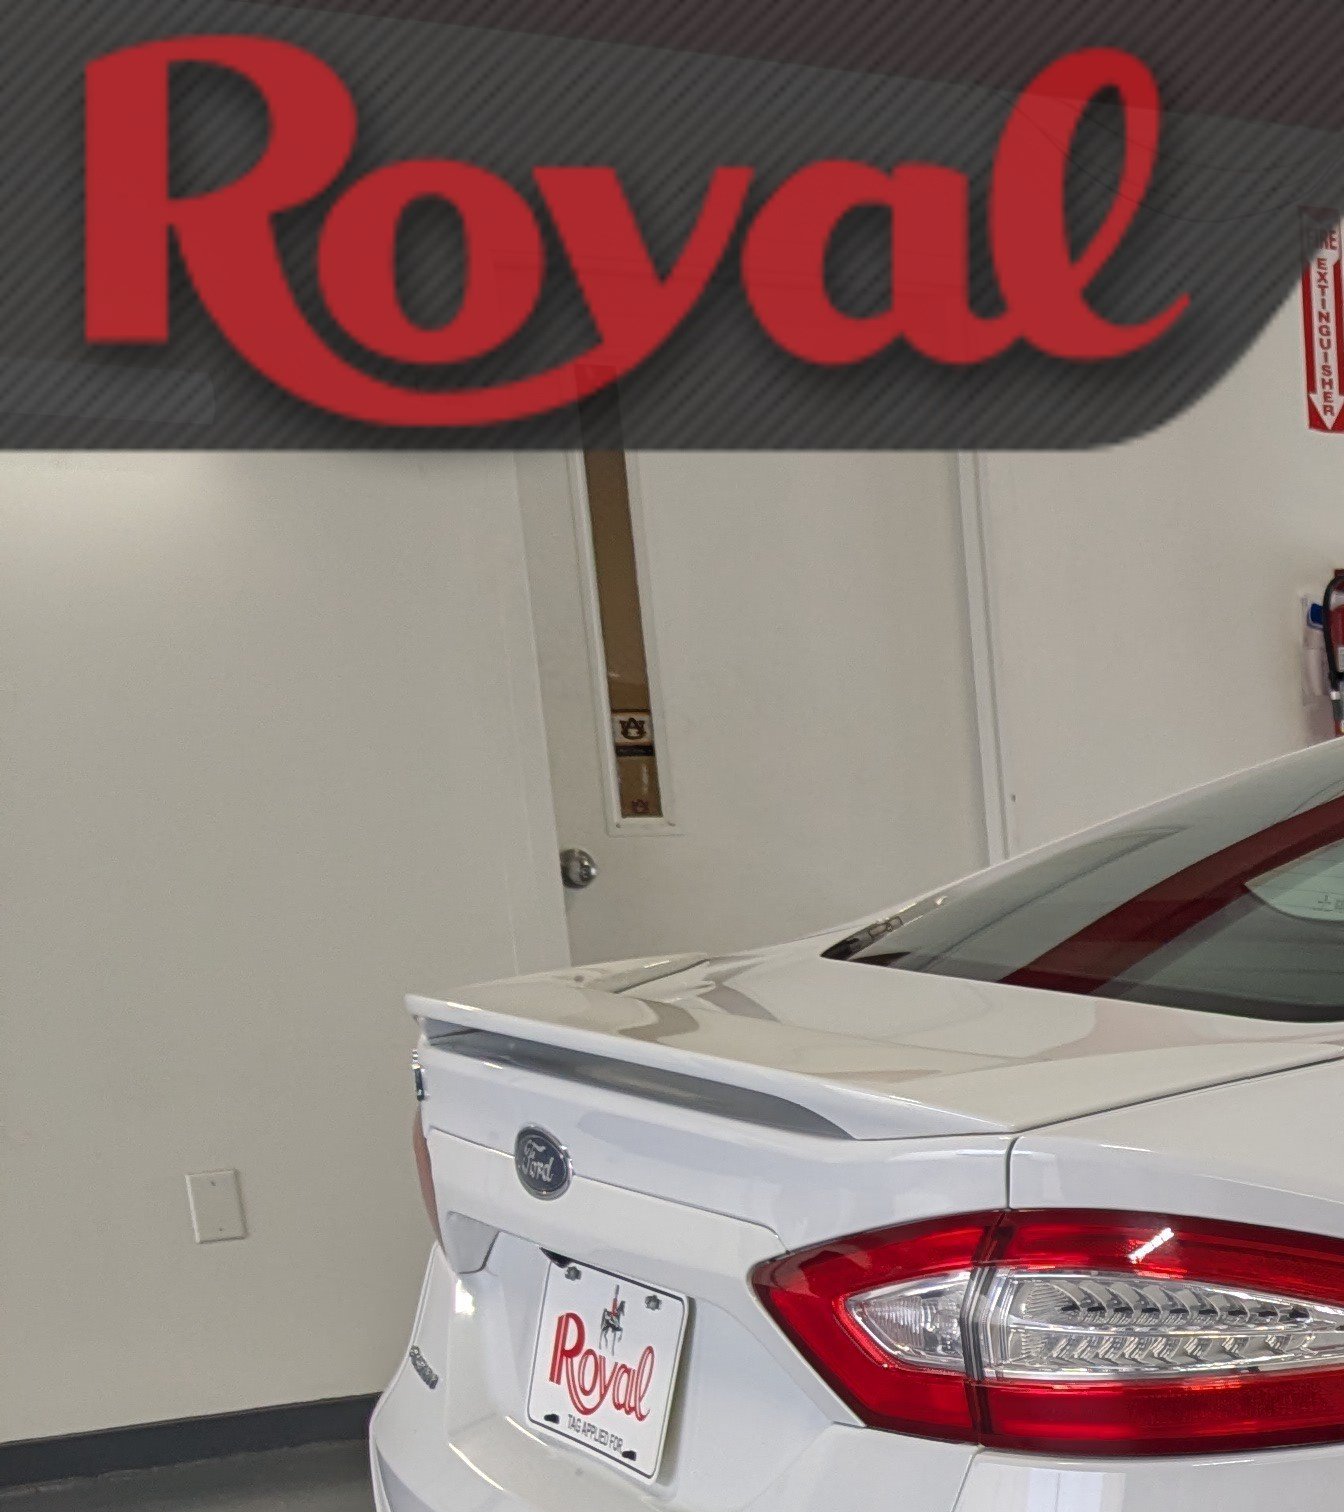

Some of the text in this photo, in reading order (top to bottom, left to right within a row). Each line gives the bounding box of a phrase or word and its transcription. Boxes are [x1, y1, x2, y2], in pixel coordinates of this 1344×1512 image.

[1316, 257, 1336, 417] EXTINGUISHER
[521, 1138, 555, 1183] Ford
[549, 1311, 655, 1423] Royal
[566, 1413, 583, 1435] TAG
[583, 1420, 610, 1448] APPLIED
